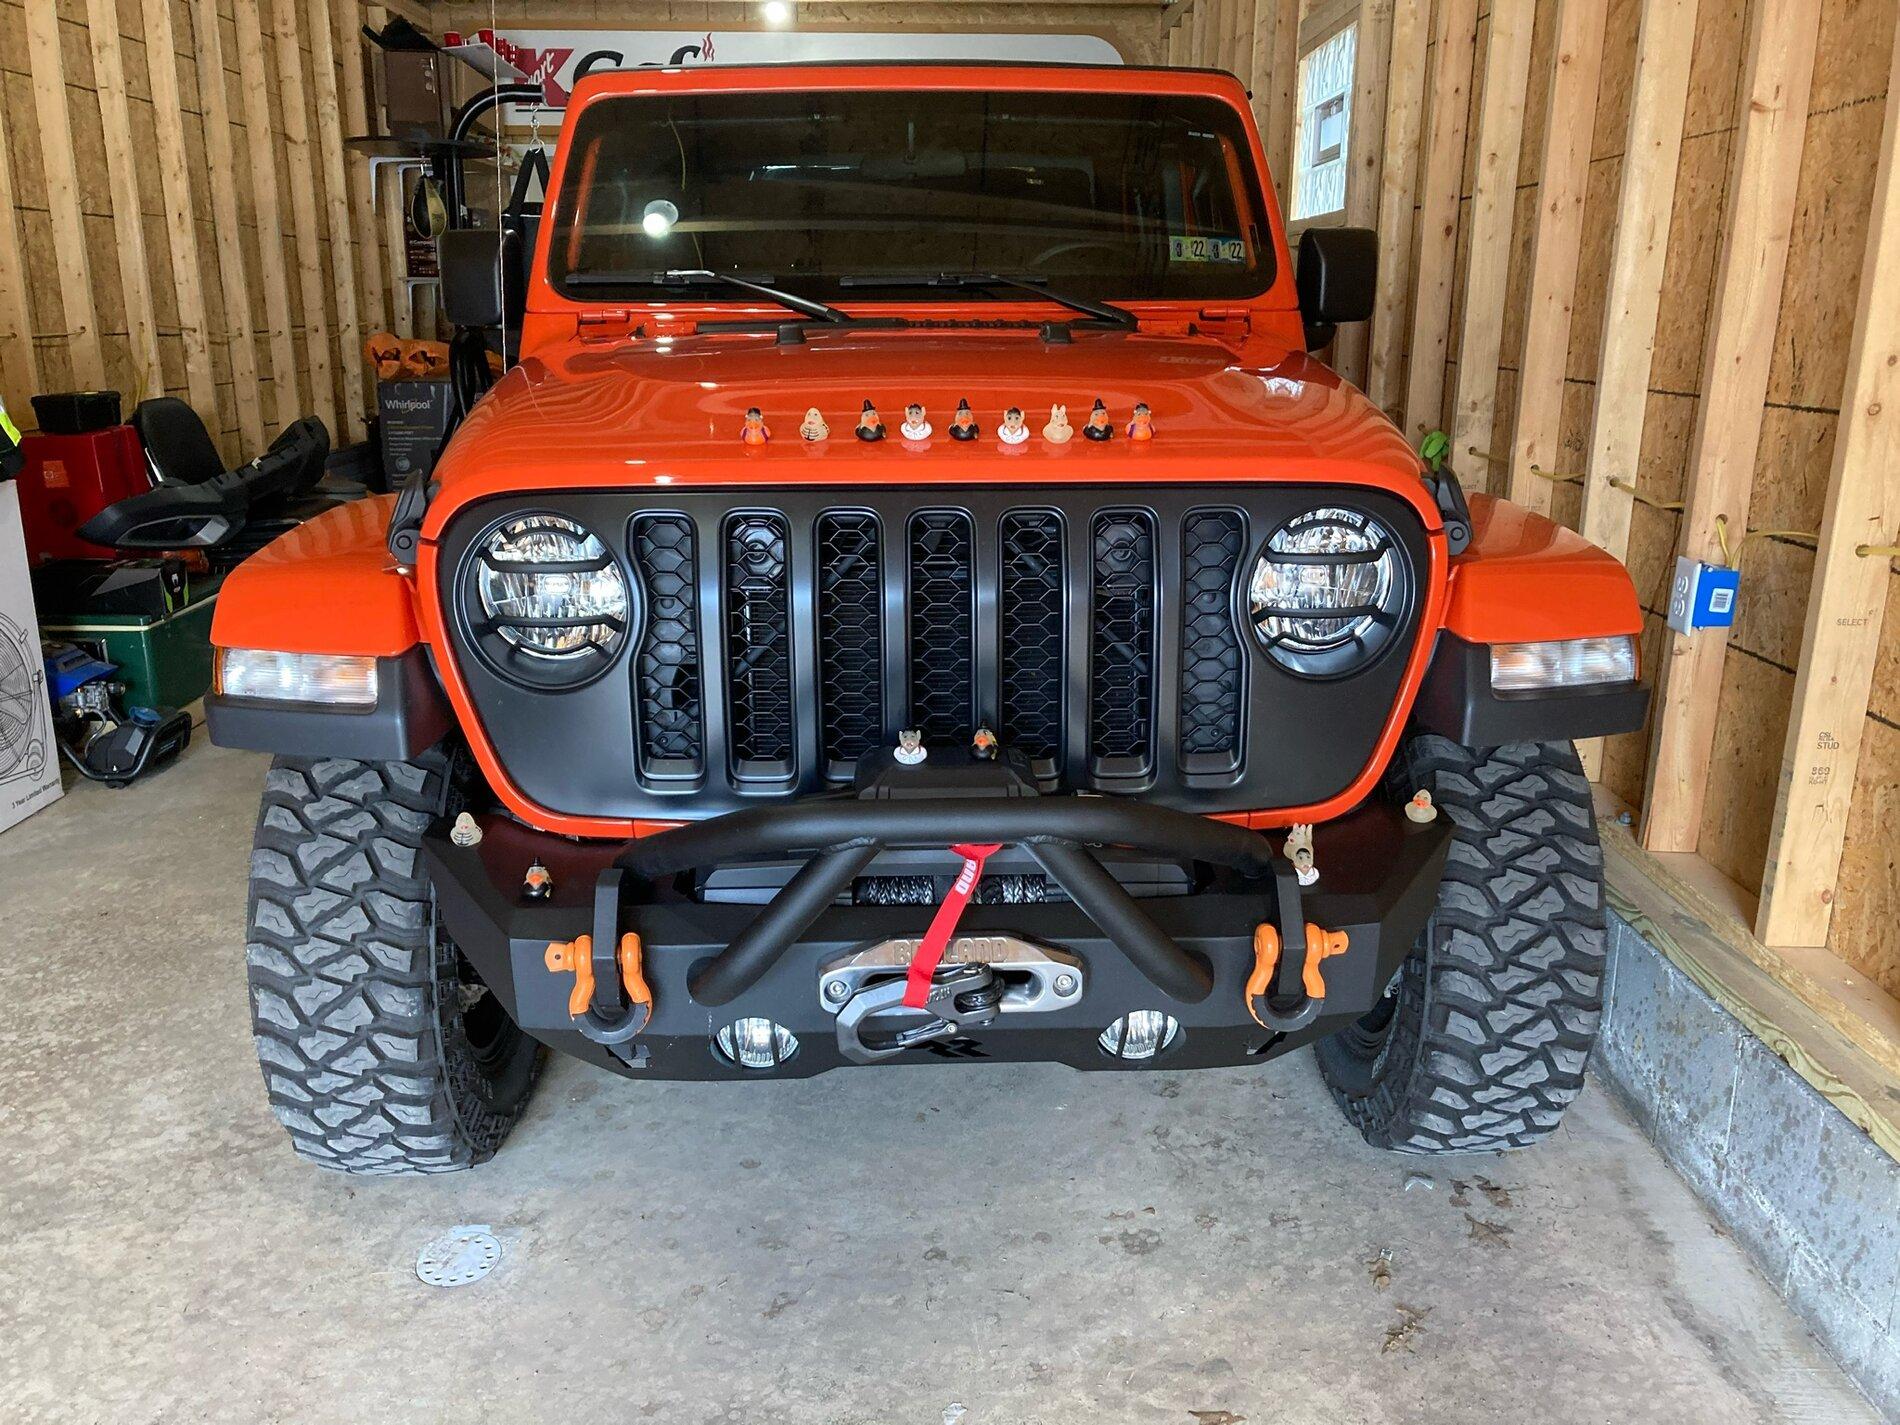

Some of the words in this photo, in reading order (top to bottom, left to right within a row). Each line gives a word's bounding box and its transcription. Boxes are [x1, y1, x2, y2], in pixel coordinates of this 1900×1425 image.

[385, 400, 431, 411] Whirlpool
[1837, 618, 1868, 626] SELECT
[1817, 741, 1840, 750] STUD
